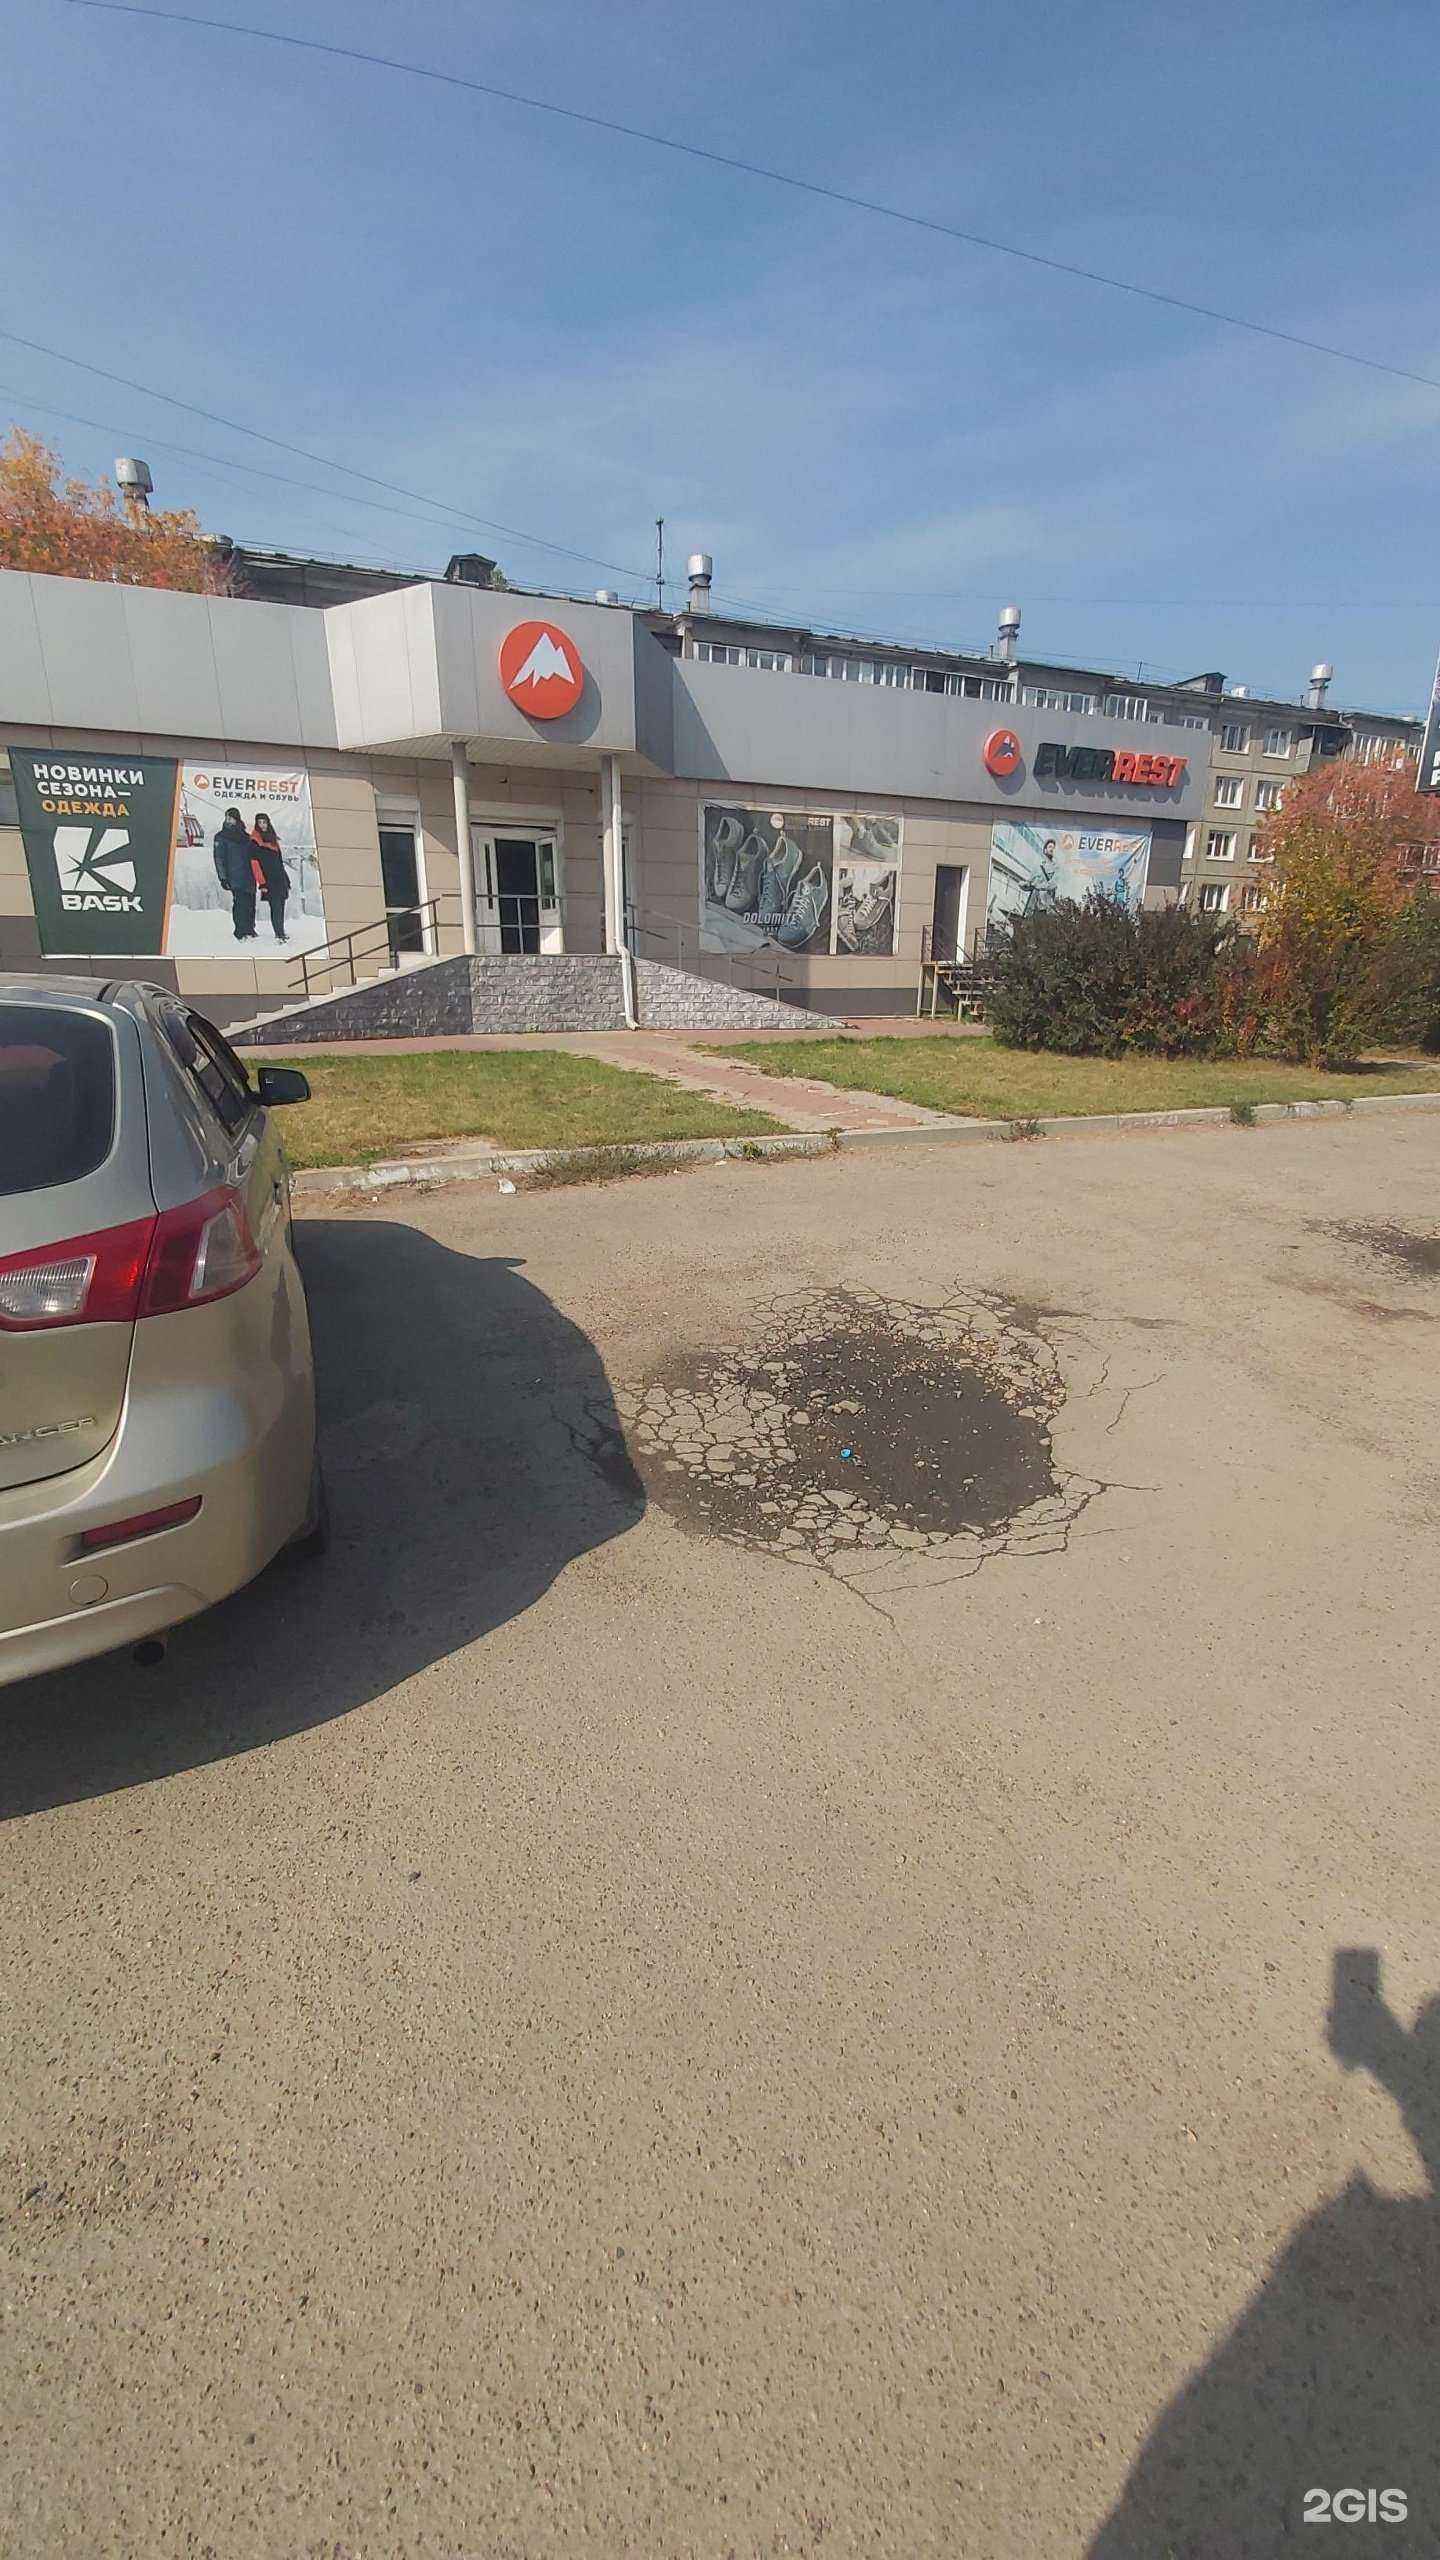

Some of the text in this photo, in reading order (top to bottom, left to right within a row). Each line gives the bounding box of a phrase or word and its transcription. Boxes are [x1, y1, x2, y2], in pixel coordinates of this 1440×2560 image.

[33, 764, 144, 785] НОВИНКИ
[213, 777, 298, 793] EVERREST
[214, 790, 256, 800] ОДЕЖДА
[269, 793, 299, 802] ОБУВЬ
[42, 800, 130, 818] ОДЕЖДА
[61, 894, 143, 912] BASK
